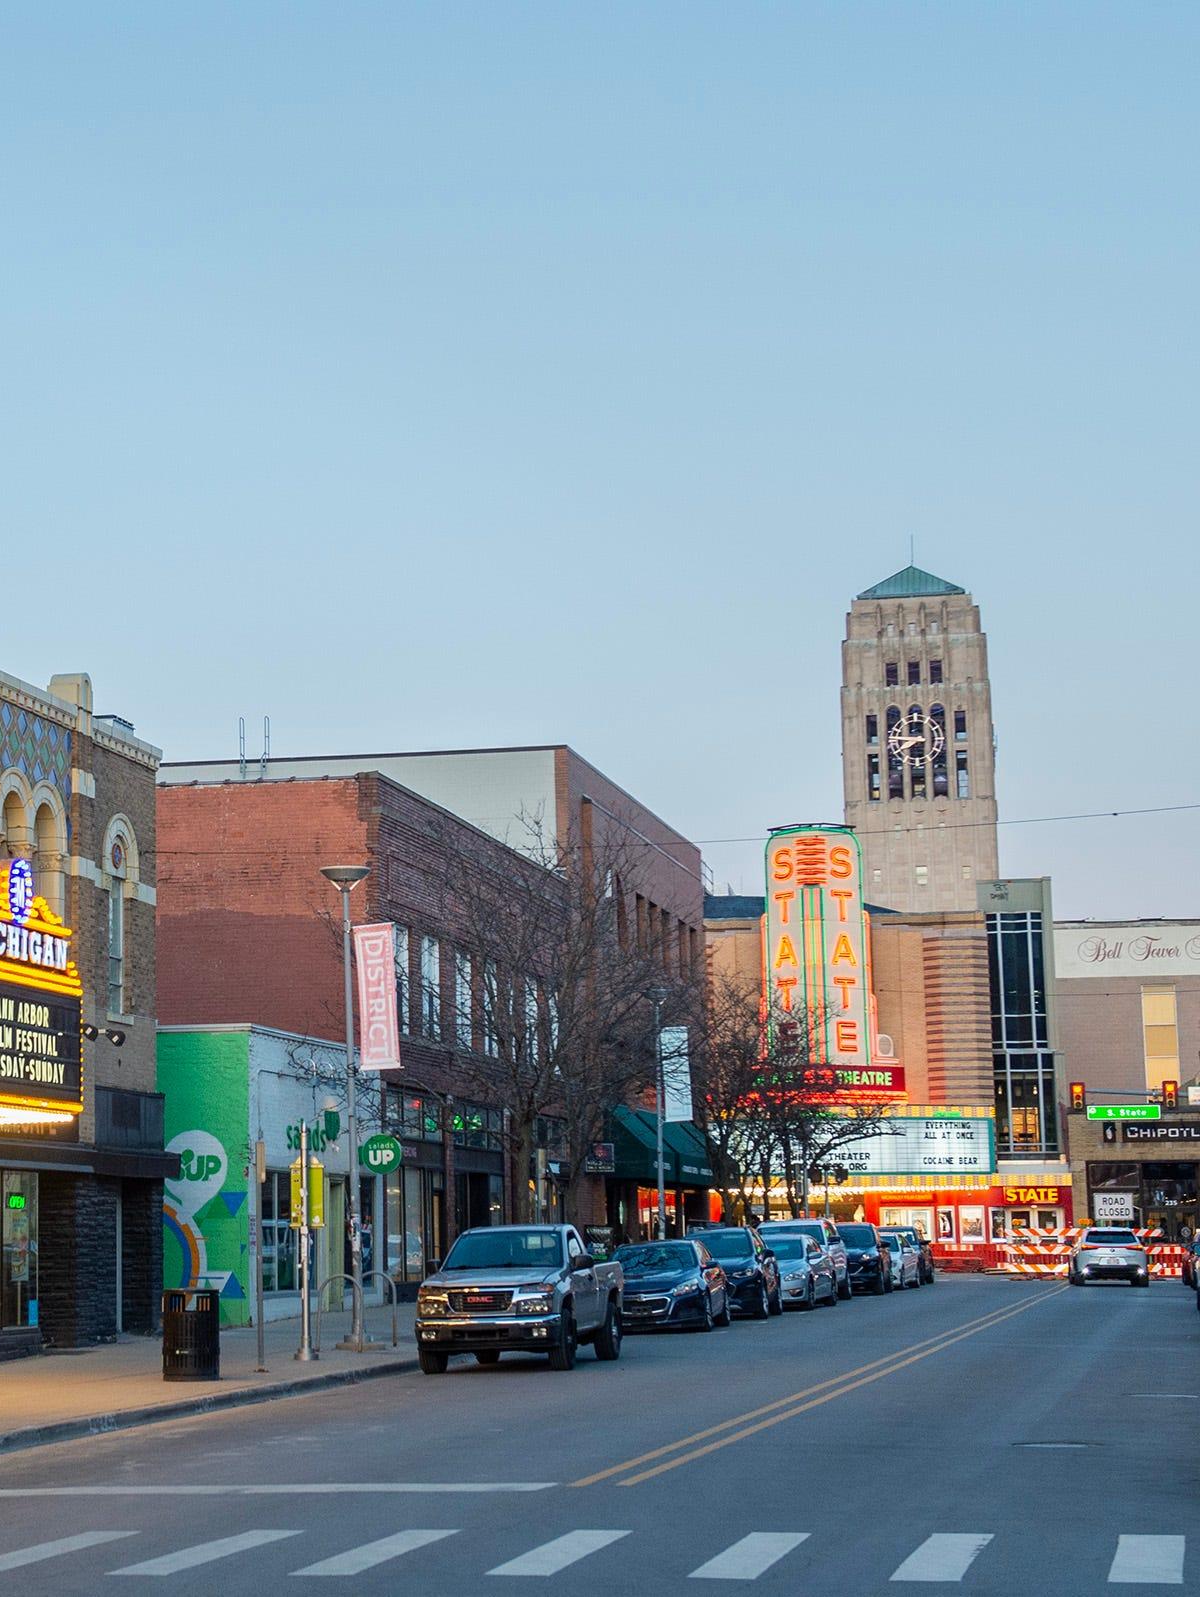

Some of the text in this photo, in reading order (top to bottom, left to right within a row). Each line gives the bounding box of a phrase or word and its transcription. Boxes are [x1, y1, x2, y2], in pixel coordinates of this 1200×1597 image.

[773, 847, 798, 1054] STATE
[829, 846, 858, 1053] STATE
[1078, 936, 1124, 963] Bell
[1128, 935, 1181, 962] Tower
[364, 938, 389, 1058] DISTRICT
[18, 1002, 49, 1028] ARBOR
[16, 1028, 58, 1057] FESTIVAL
[835, 1070, 893, 1087] THEATRE
[1120, 1109, 1147, 1117] State
[925, 1121, 971, 1129] EVERYTHING
[286, 1118, 327, 1153] saads
[923, 1131, 975, 1140] ALL AT ONCE
[368, 1142, 395, 1150] salads
[368, 1150, 395, 1166] UP
[829, 1152, 871, 1161] THEATER
[923, 1157, 978, 1165] COCAINE BEAR
[1005, 1187, 1059, 1202] STATE
[1102, 1197, 1126, 1206] ROAD
[1097, 1207, 1131, 1217] CLOSED
[467, 1295, 495, 1304] GMC
